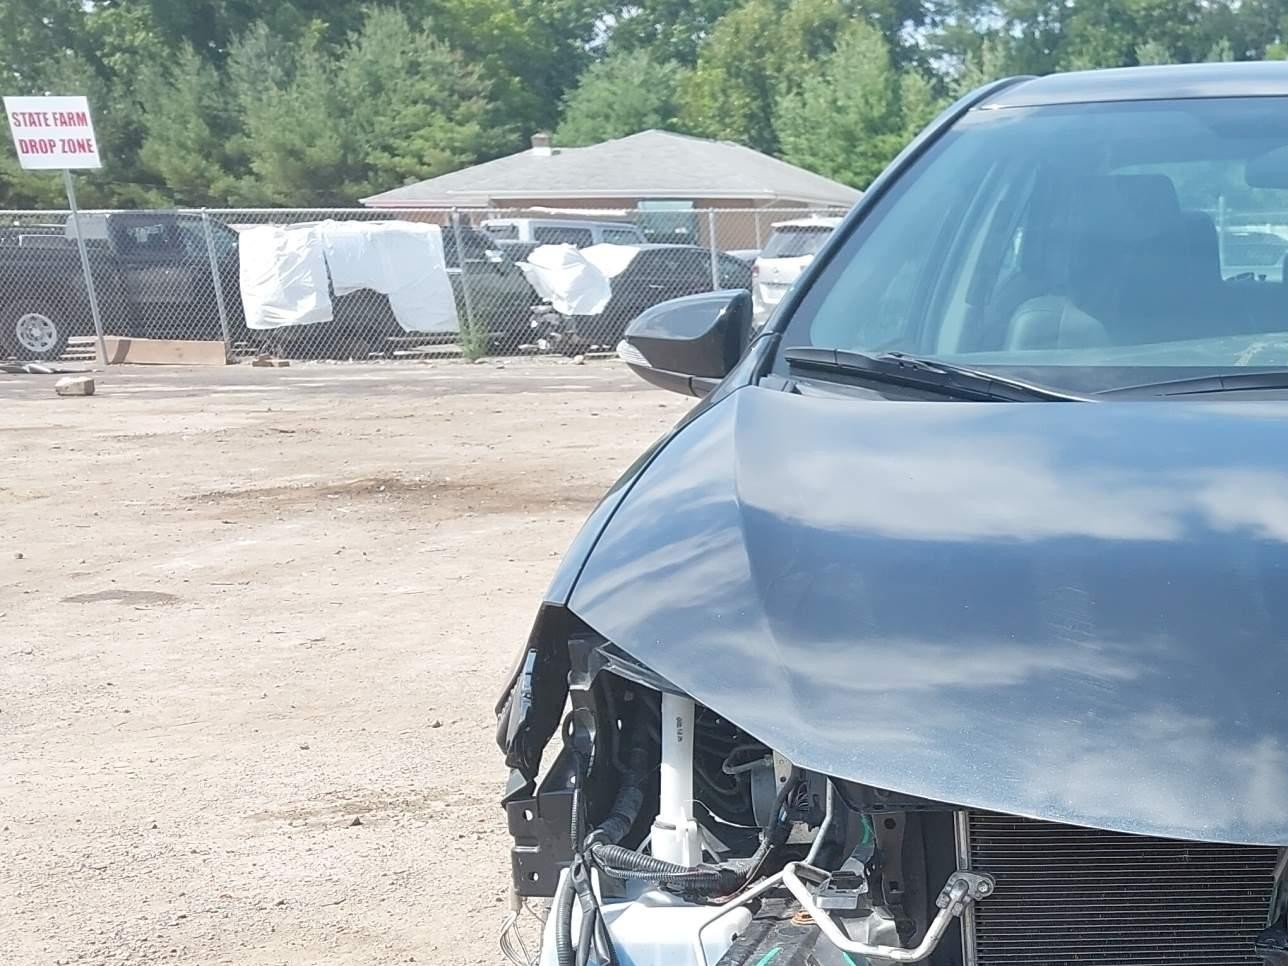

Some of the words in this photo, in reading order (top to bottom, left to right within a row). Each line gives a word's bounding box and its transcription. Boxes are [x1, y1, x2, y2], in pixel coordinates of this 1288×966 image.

[11, 111, 51, 128] STATE
[51, 111, 88, 127] FARM
[18, 138, 56, 154] DROP
[58, 138, 95, 154] ZONE
